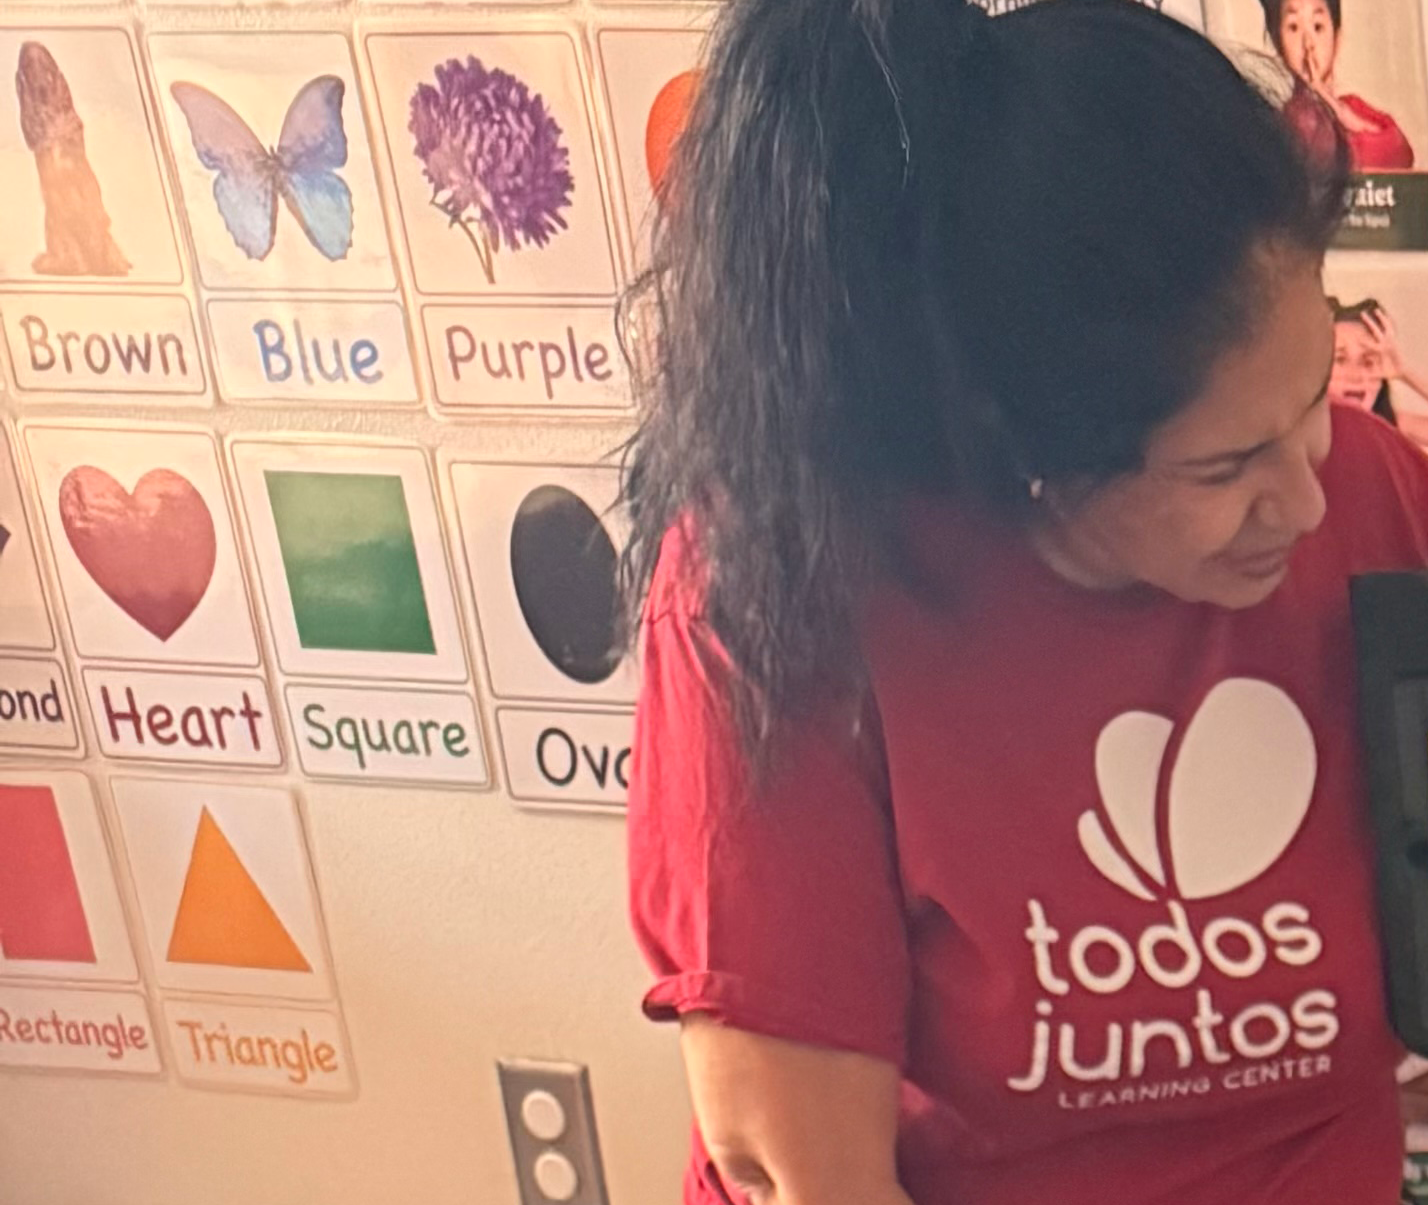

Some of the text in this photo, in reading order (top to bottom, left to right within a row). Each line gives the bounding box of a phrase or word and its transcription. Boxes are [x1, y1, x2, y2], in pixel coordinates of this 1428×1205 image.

[19, 314, 188, 377] Brown
[253, 319, 384, 385] Blue
[445, 324, 613, 400] Purple
[0, 678, 64, 723] ond
[101, 685, 263, 751] Heart
[302, 704, 471, 770] Square
[1025, 899, 1322, 996] todos
[0, 1008, 148, 1060] Rectangle
[177, 1021, 338, 1085] Triangle
[1008, 988, 1340, 1092] juntos
[1058, 1055, 1332, 1110] LEARNING CENTER
